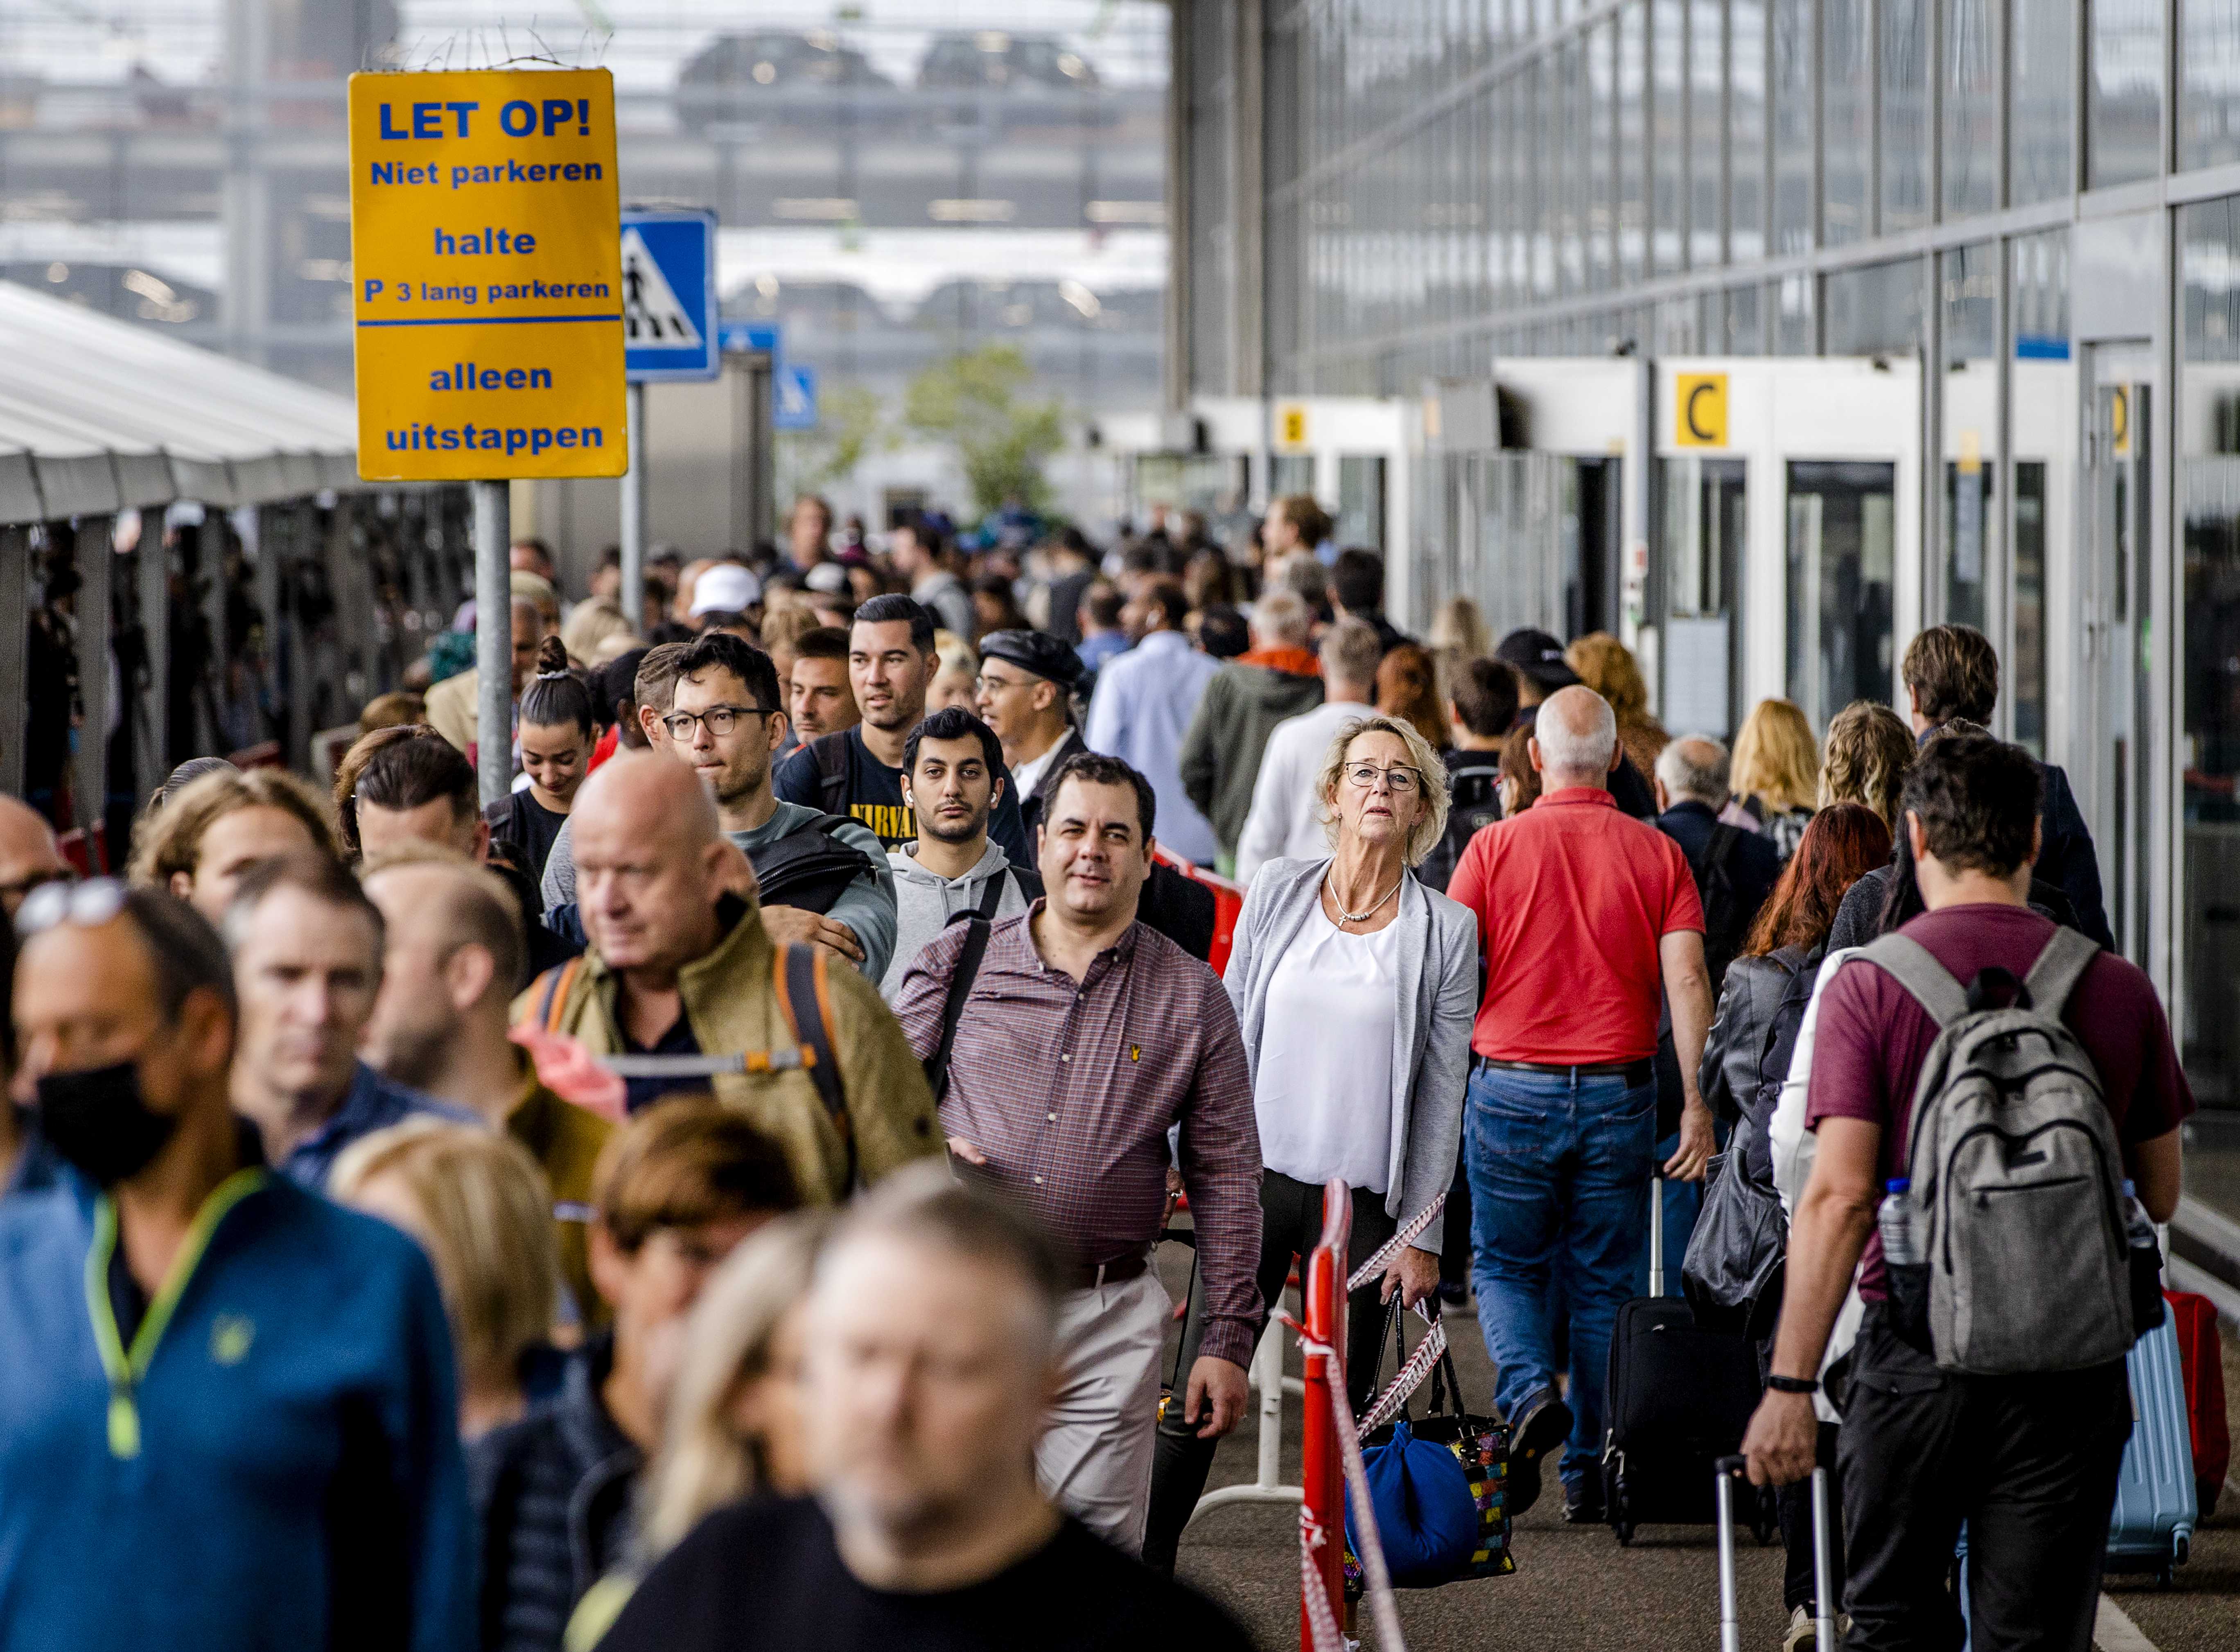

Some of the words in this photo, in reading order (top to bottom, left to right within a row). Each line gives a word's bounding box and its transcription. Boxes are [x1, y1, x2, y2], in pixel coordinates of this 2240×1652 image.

[380, 102, 479, 140] LET
[500, 99, 589, 138] OP!
[371, 162, 438, 185] Niet
[452, 159, 602, 190] parkeren
[435, 227, 535, 255] halte
[365, 279, 384, 302] P
[397, 282, 412, 302] 3
[422, 282, 477, 305] lang
[488, 280, 609, 304] parkeren
[430, 363, 551, 391] alleen
[1687, 383, 1716, 441] C
[387, 423, 603, 456] uitstappen
[851, 803, 917, 838] NIRVA
